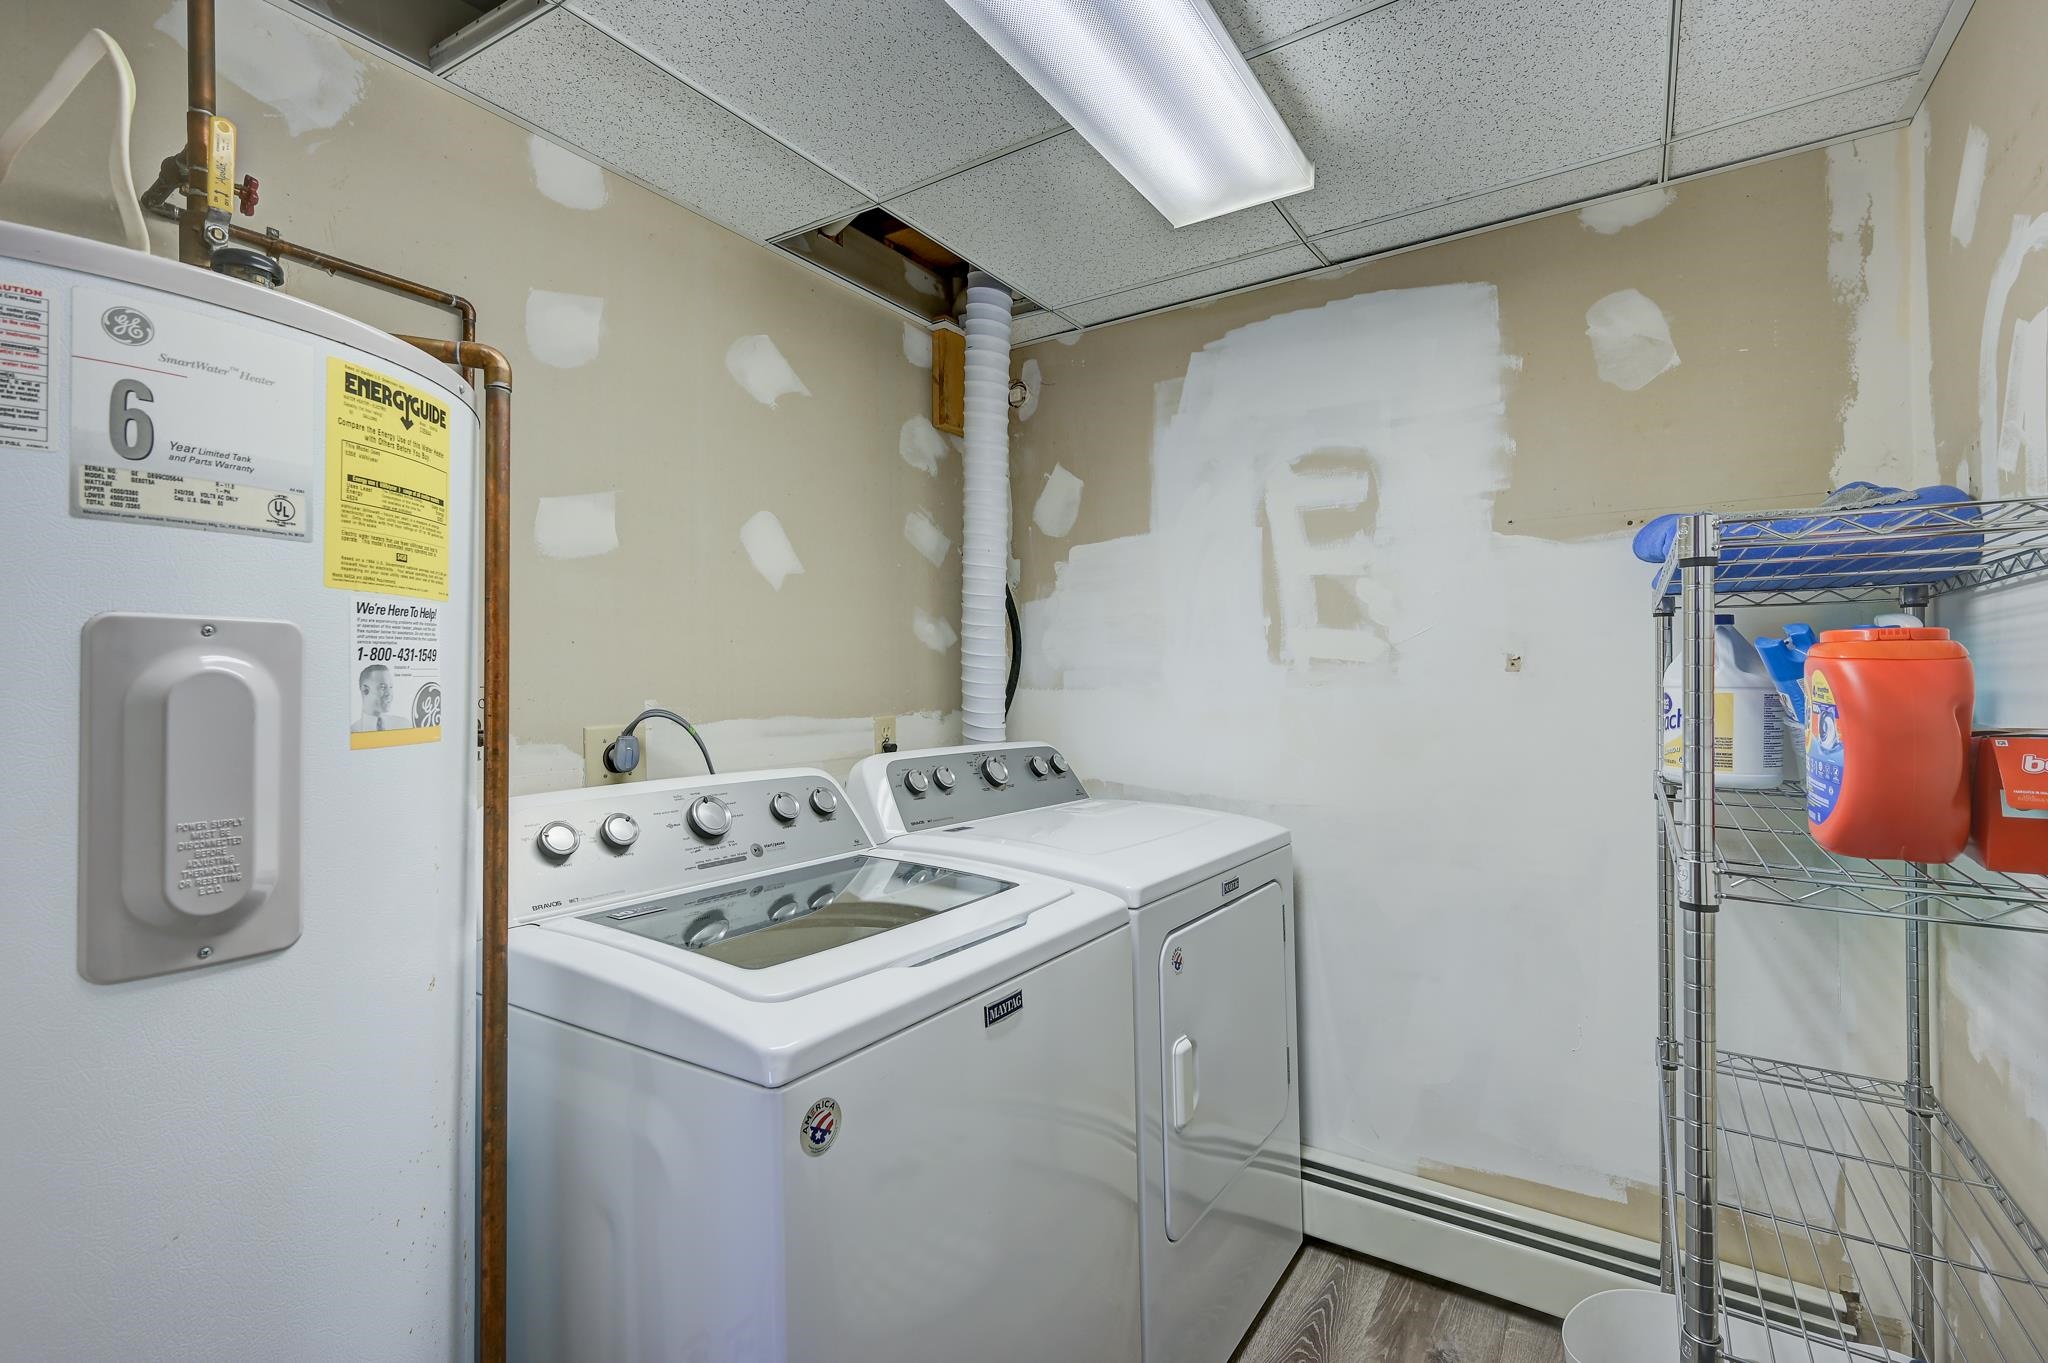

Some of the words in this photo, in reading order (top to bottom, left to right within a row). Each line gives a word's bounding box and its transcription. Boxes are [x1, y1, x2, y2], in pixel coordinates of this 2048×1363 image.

[240, 371, 276, 387] Heater
[109, 379, 154, 461] 6
[337, 417, 365, 431] Compare
[367, 424, 376, 434] the
[377, 428, 395, 441] Energy
[169, 441, 197, 454] Year
[198, 447, 230, 460] Limited
[233, 453, 252, 463] Tank
[365, 434, 377, 443] with
[379, 437, 395, 449] Others
[396, 442, 412, 454] Before
[412, 447, 420, 456] You
[168, 454, 186, 463] and
[189, 457, 212, 467] Parts
[215, 460, 255, 474] Warranty
[357, 601, 386, 616] We're
[387, 604, 409, 617] Here
[410, 606, 418, 618] To
[419, 608, 437, 622] Help!
[358, 647, 437, 662] 1-800-431-1549
[176, 821, 207, 832] POWER
[211, 818, 244, 830] SUPPLY
[191, 829, 216, 841] MUST
[220, 828, 231, 838] BE
[177, 836, 242, 852] DISCONNECTED
[194, 847, 227, 859] BEFORE
[186, 855, 235, 870] ADJUSTING
[181, 864, 240, 880] THERMOSTAT
[178, 879, 191, 890] OR
[195, 873, 242, 887] RESETTING
[532, 901, 562, 912] BRAVOS
[989, 995, 1021, 1021] MAYTAG
[803, 1100, 835, 1135] AMERICA
